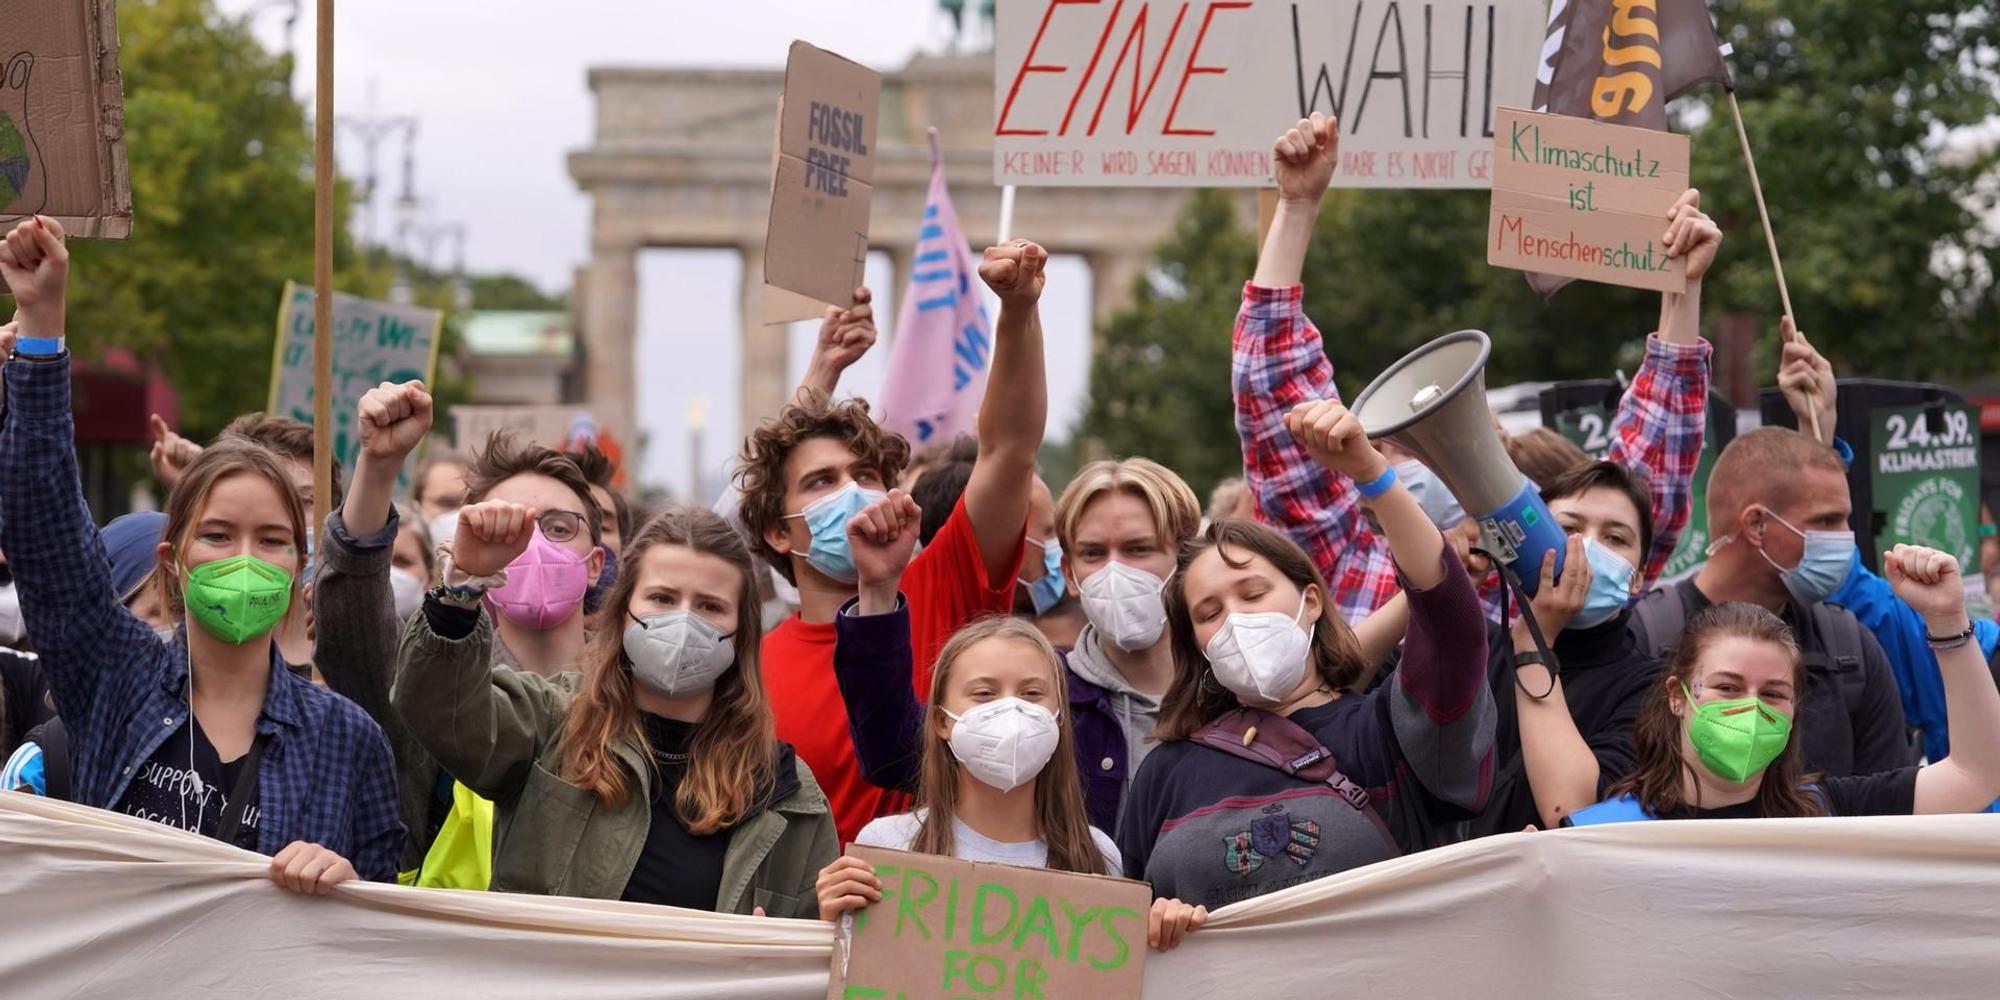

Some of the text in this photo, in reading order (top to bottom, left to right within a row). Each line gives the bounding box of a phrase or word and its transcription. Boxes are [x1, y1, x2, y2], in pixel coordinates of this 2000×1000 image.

[995, 0, 1254, 136] EINE
[1292, 0, 1496, 138] WAHL
[809, 101, 868, 156] FOSSIL
[1511, 120, 1661, 178] Klimaschutz
[804, 147, 850, 198] FREE
[1101, 151, 1138, 176] WIRD
[1147, 151, 1197, 177] SAGEN
[1207, 149, 1270, 177] KÖNNEN
[1342, 151, 1377, 177] HABE
[1387, 151, 1405, 178] ES
[1413, 151, 1457, 179] NICHT
[1467, 149, 1494, 180] GE
[1569, 181, 1599, 211] ist
[1498, 213, 1673, 273] Menschenschutz
[854, 864, 1143, 971] FRIDAYS
[941, 949, 1050, 1000] FOR
